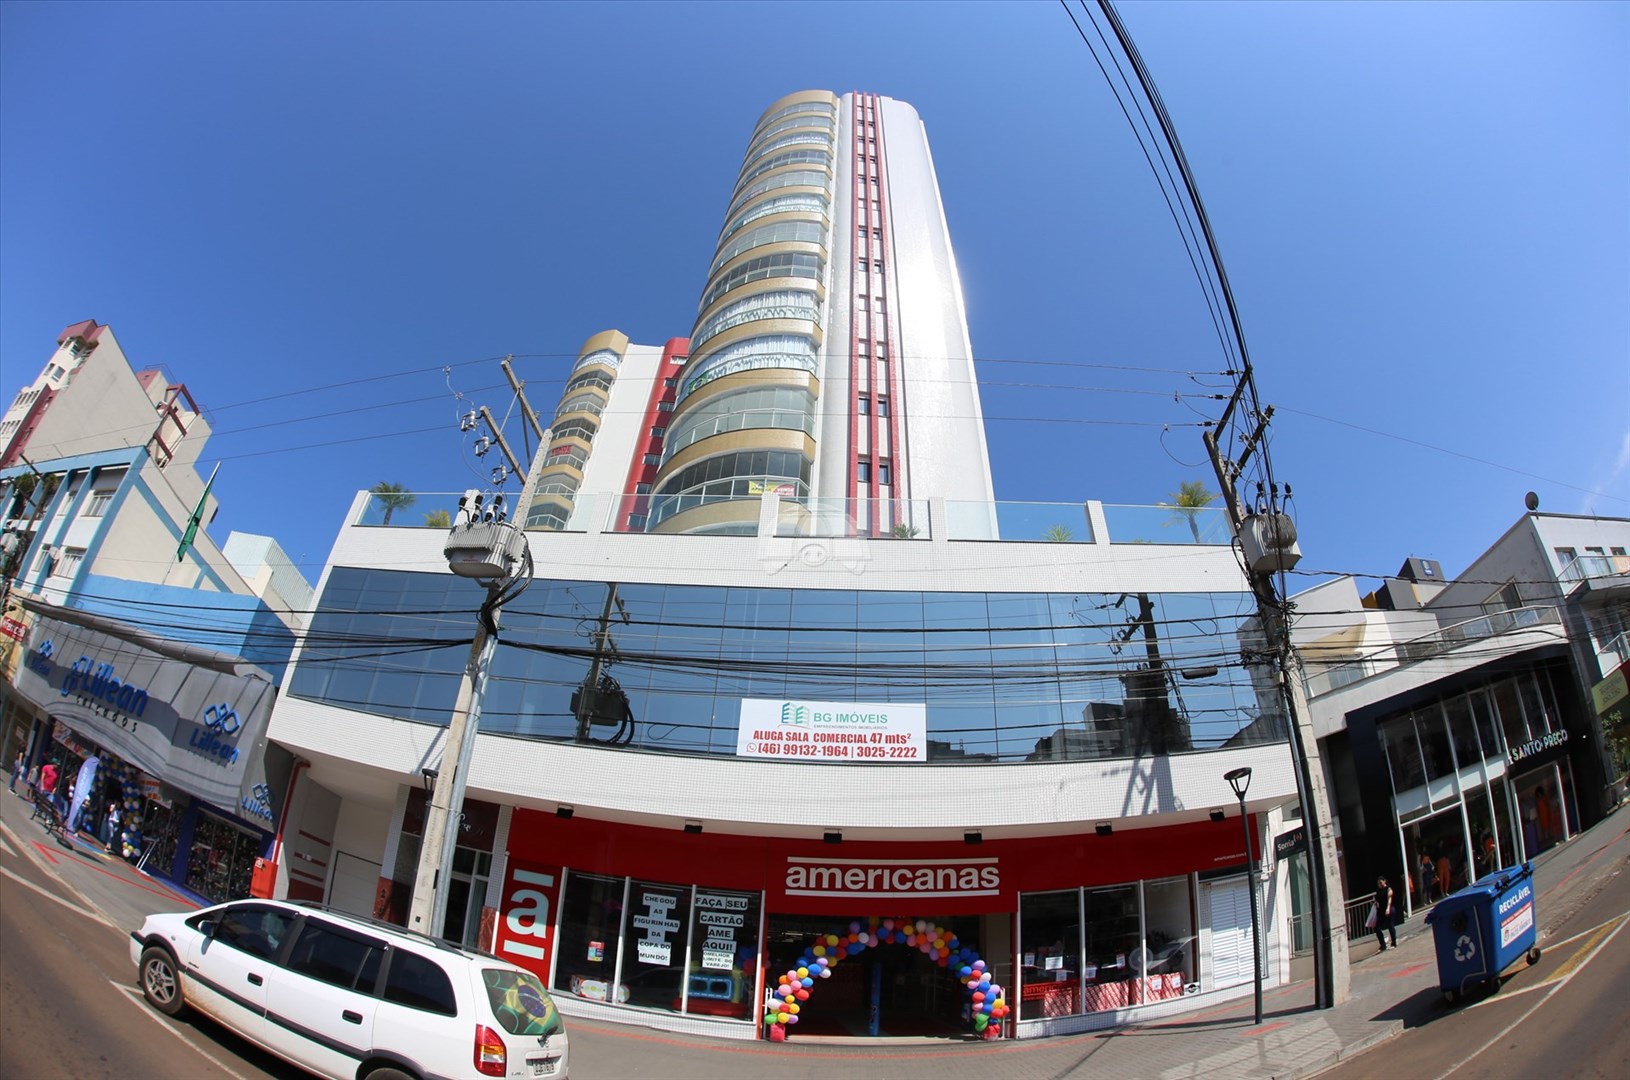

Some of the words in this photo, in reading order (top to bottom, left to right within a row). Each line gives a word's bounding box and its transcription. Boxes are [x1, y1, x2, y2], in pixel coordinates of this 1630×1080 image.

[80, 657, 150, 717] Lillean
[813, 712, 832, 723] BG
[836, 711, 888, 724] IMÓVEIS
[753, 730, 784, 741] ALUGA
[785, 731, 809, 742] SALA
[813, 733, 868, 744] COMERCIAL
[869, 732, 883, 744] 47
[189, 727, 241, 765] Lillean
[758, 743, 780, 754] (46)
[783, 744, 848, 757] 99132-1964
[857, 746, 917, 758] 3025-2222
[785, 866, 1000, 890] americanas
[644, 895, 675, 905] CHEGOU
[695, 897, 723, 907] FAÇA
[726, 900, 748, 909] SEU
[1498, 886, 1531, 915] RECICLÁVEL
[505, 888, 550, 940] a
[700, 914, 743, 925] CARTÃO
[708, 929, 731, 938] AME
[703, 941, 733, 951] AQUI!
